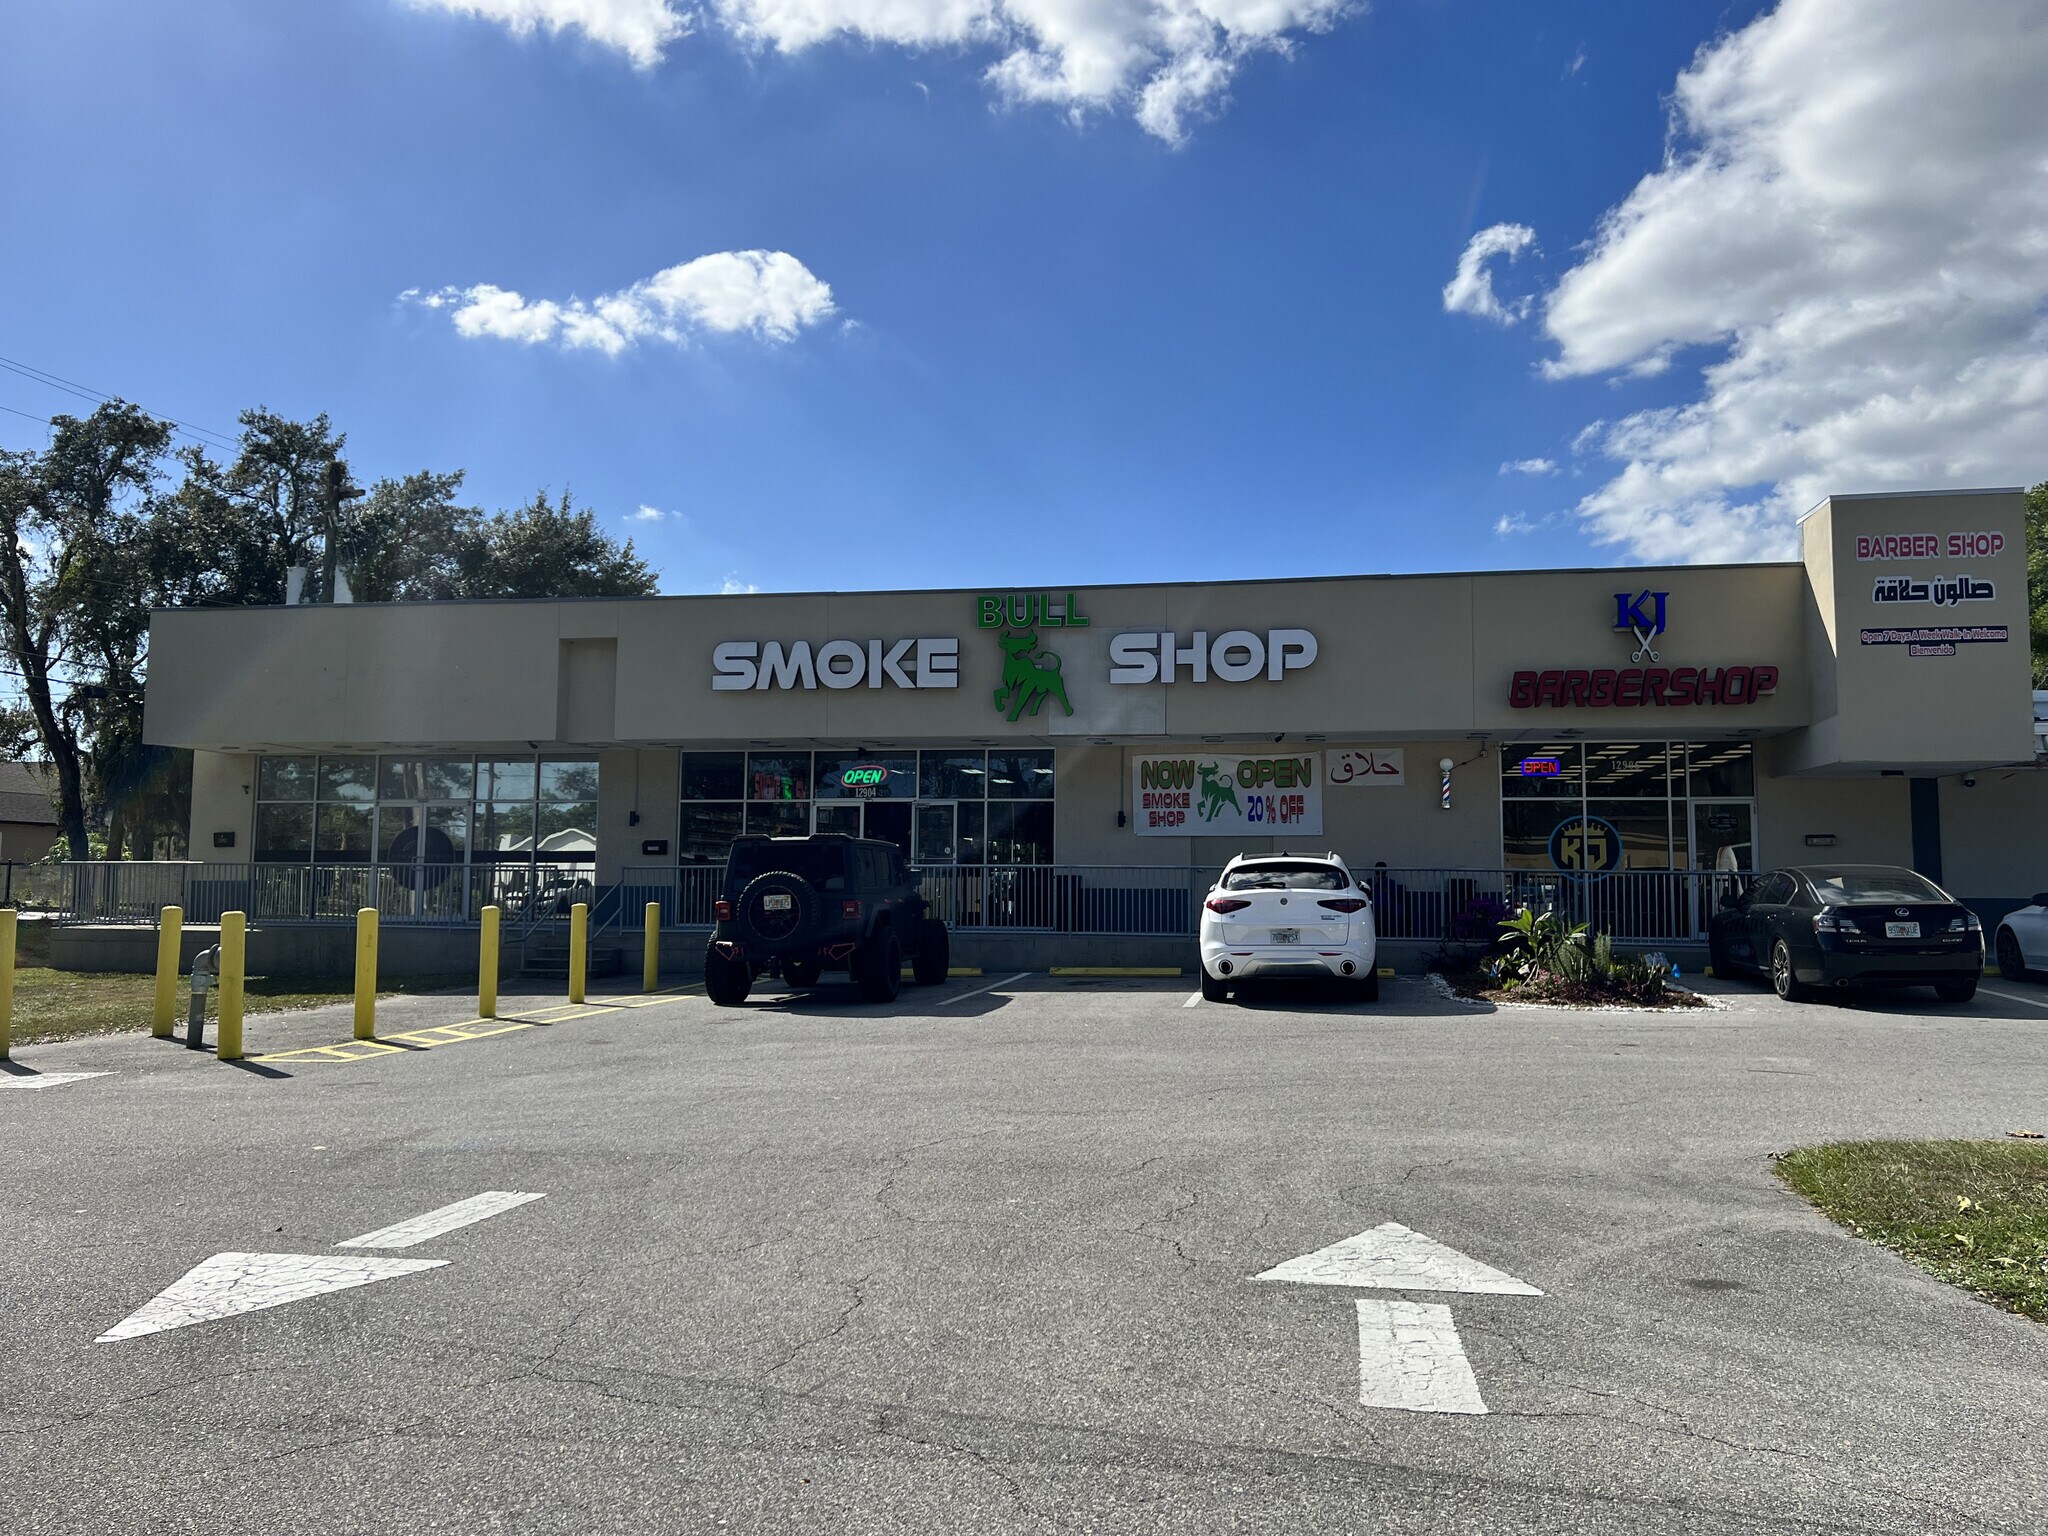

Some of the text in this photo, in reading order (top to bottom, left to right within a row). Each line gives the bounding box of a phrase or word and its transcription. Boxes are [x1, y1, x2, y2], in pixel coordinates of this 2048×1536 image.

[1857, 533, 2004, 559] BARBER SHOP
[1874, 577, 1994, 606] صالون حلاقة
[976, 593, 1090, 629] BULL
[1613, 589, 1670, 636] KJ
[1862, 631, 1884, 644] Open
[1884, 631, 1890, 641] 7
[1891, 631, 1911, 643] Days
[1911, 631, 1919, 640] A
[1919, 629, 1941, 640] Week
[1973, 628, 2007, 639] Welcome
[712, 638, 960, 691] SMOKE
[1109, 629, 1318, 684] SHOP
[1911, 645, 1954, 656] Bienvenido
[1509, 665, 1779, 708] BARBERSHOP
[844, 769, 883, 784] OPEN
[1141, 758, 1312, 790] NOW OPEN
[1331, 751, 1400, 784] حلاق
[1523, 760, 1558, 774] OPEN
[854, 787, 876, 798] 12904
[1142, 792, 1190, 809] SMOKE
[1148, 810, 1185, 827] SHOP
[1279, 795, 1304, 823] OFF
